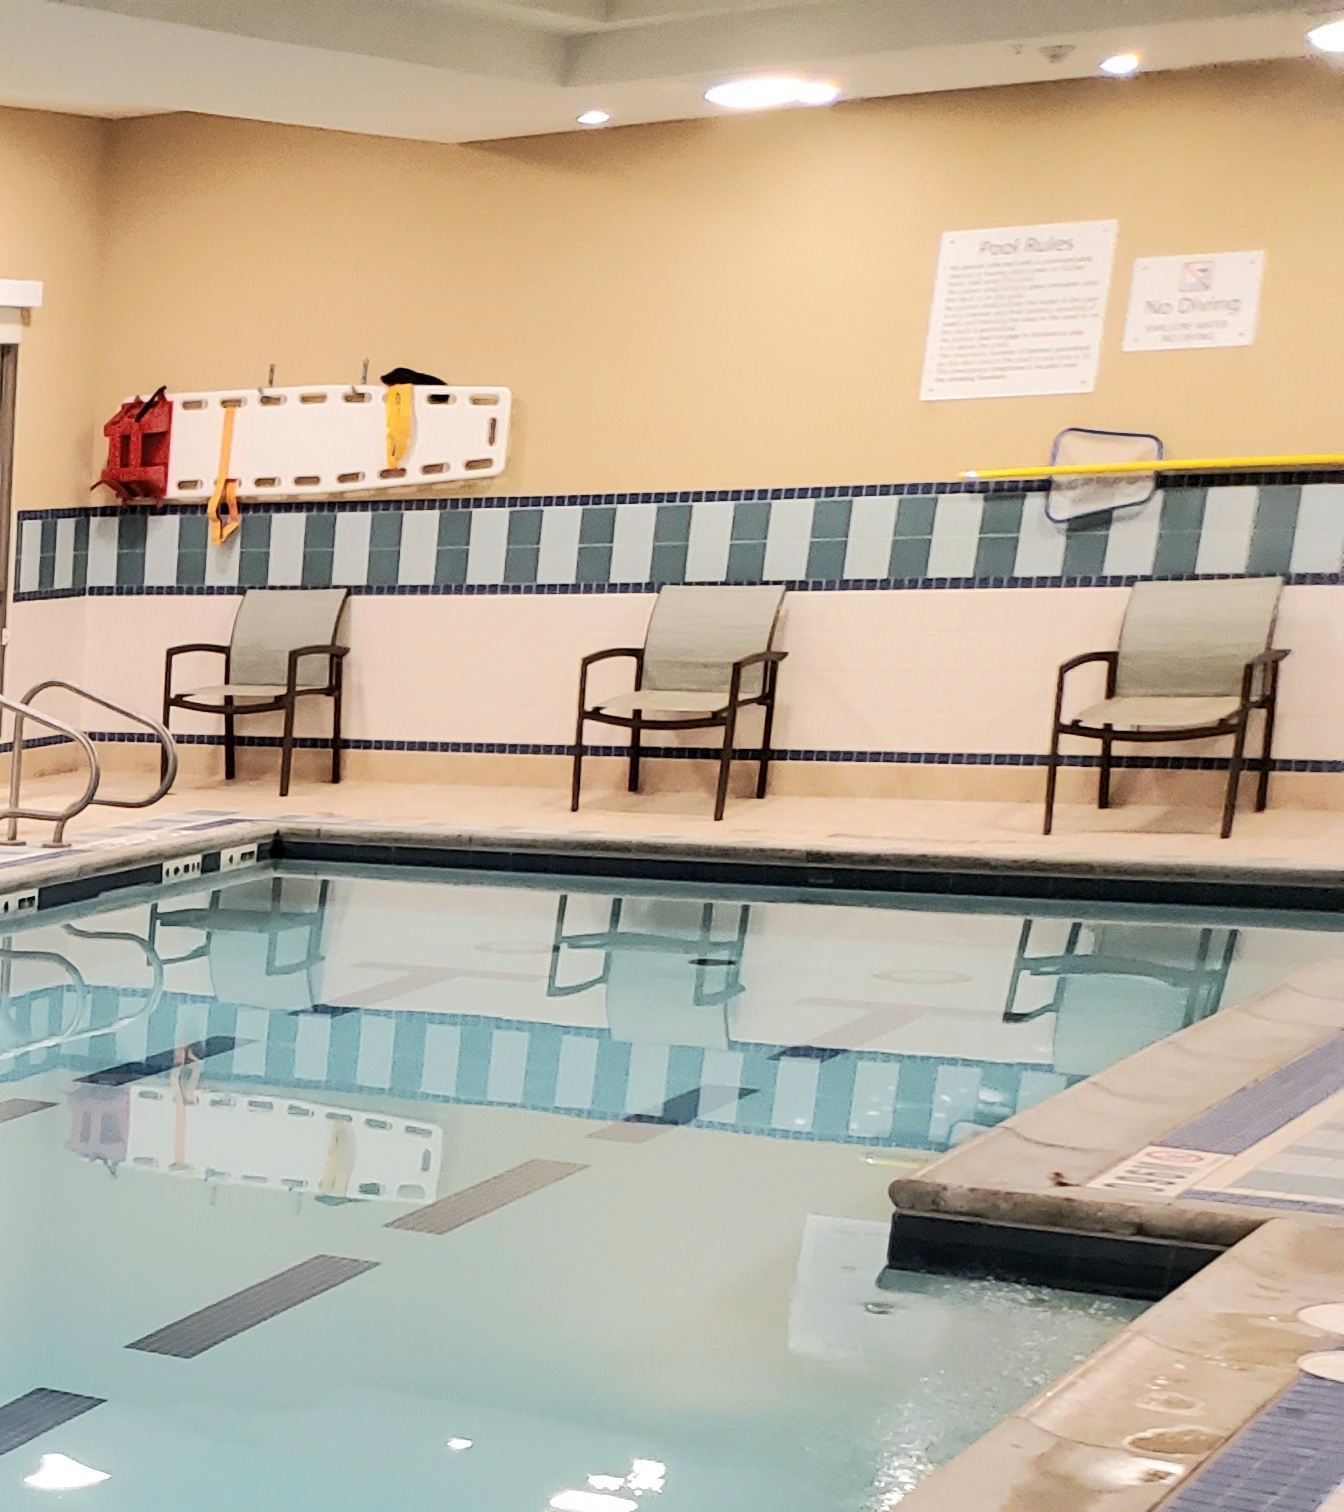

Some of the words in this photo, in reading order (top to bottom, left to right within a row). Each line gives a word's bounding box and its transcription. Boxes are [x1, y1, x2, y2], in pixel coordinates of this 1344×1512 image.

[979, 238, 1020, 255] Pool
[1024, 236, 1074, 253] Rules
[1145, 300, 1173, 315] No
[1177, 297, 1242, 316] Diving
